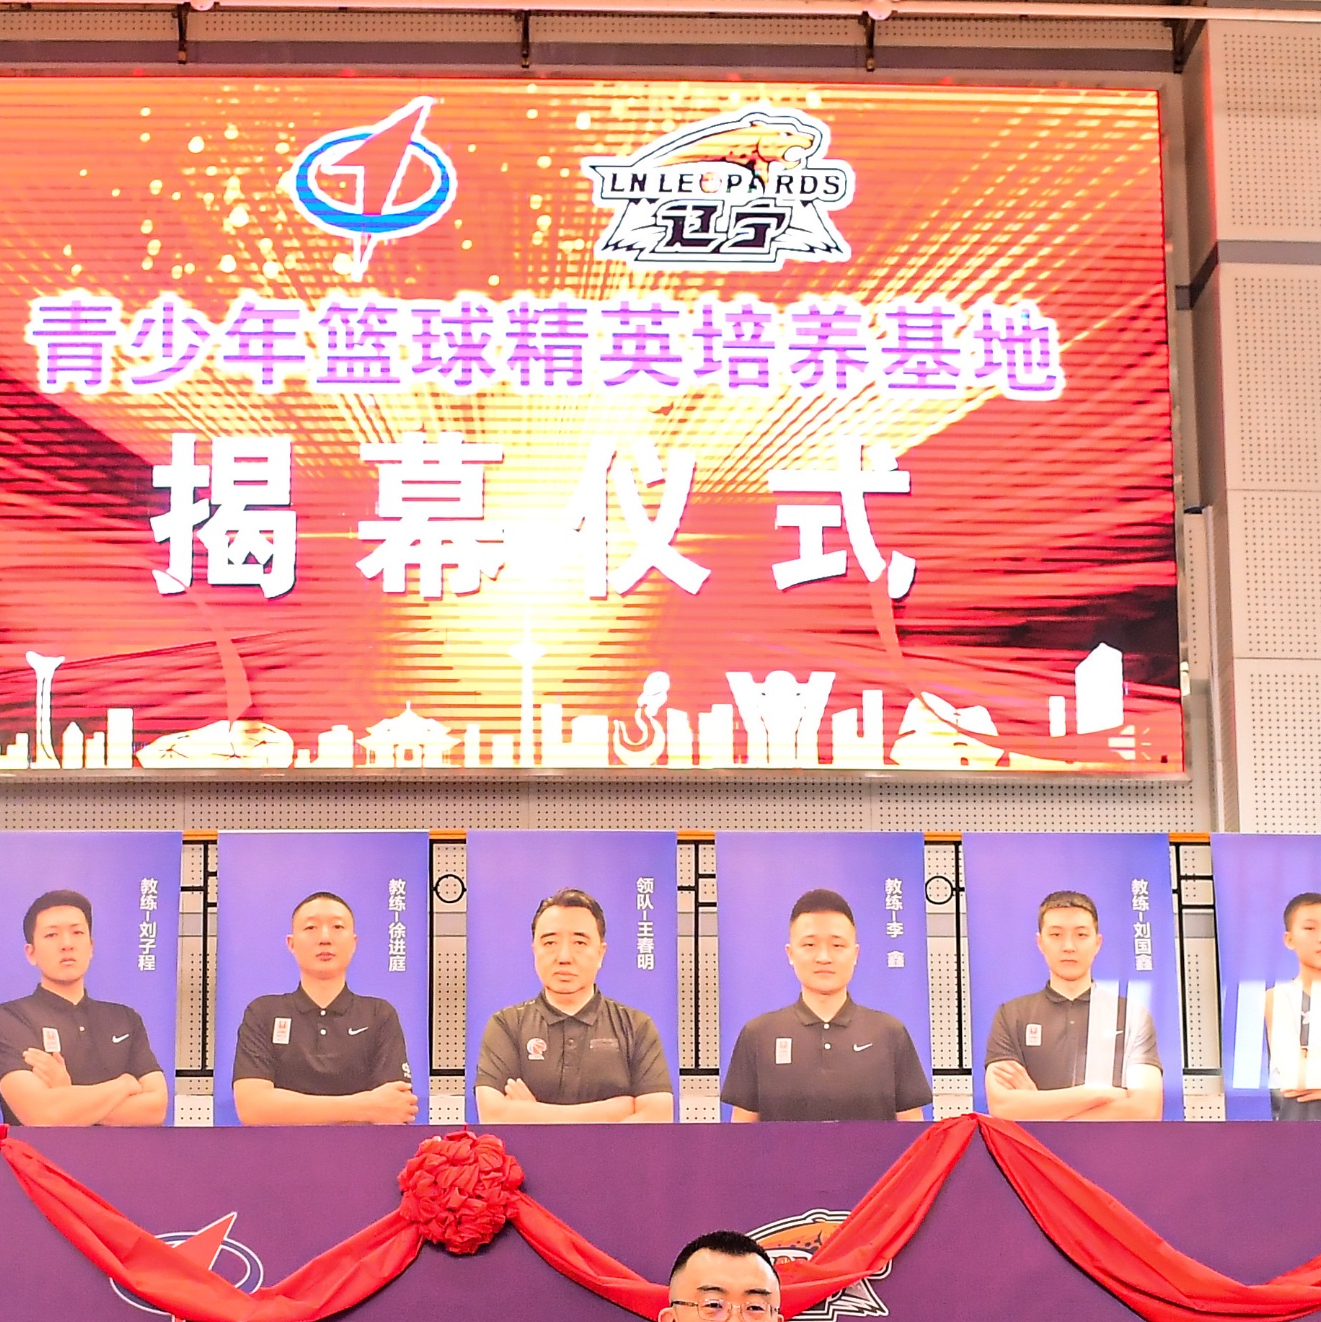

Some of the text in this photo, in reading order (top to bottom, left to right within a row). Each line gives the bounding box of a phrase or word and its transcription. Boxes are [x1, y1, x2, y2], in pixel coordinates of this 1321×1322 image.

[609, 172, 647, 193] LN
[28, 297, 1061, 396] 青少年篮球精英培养基地
[152, 432, 918, 600] 揭幕仪式
